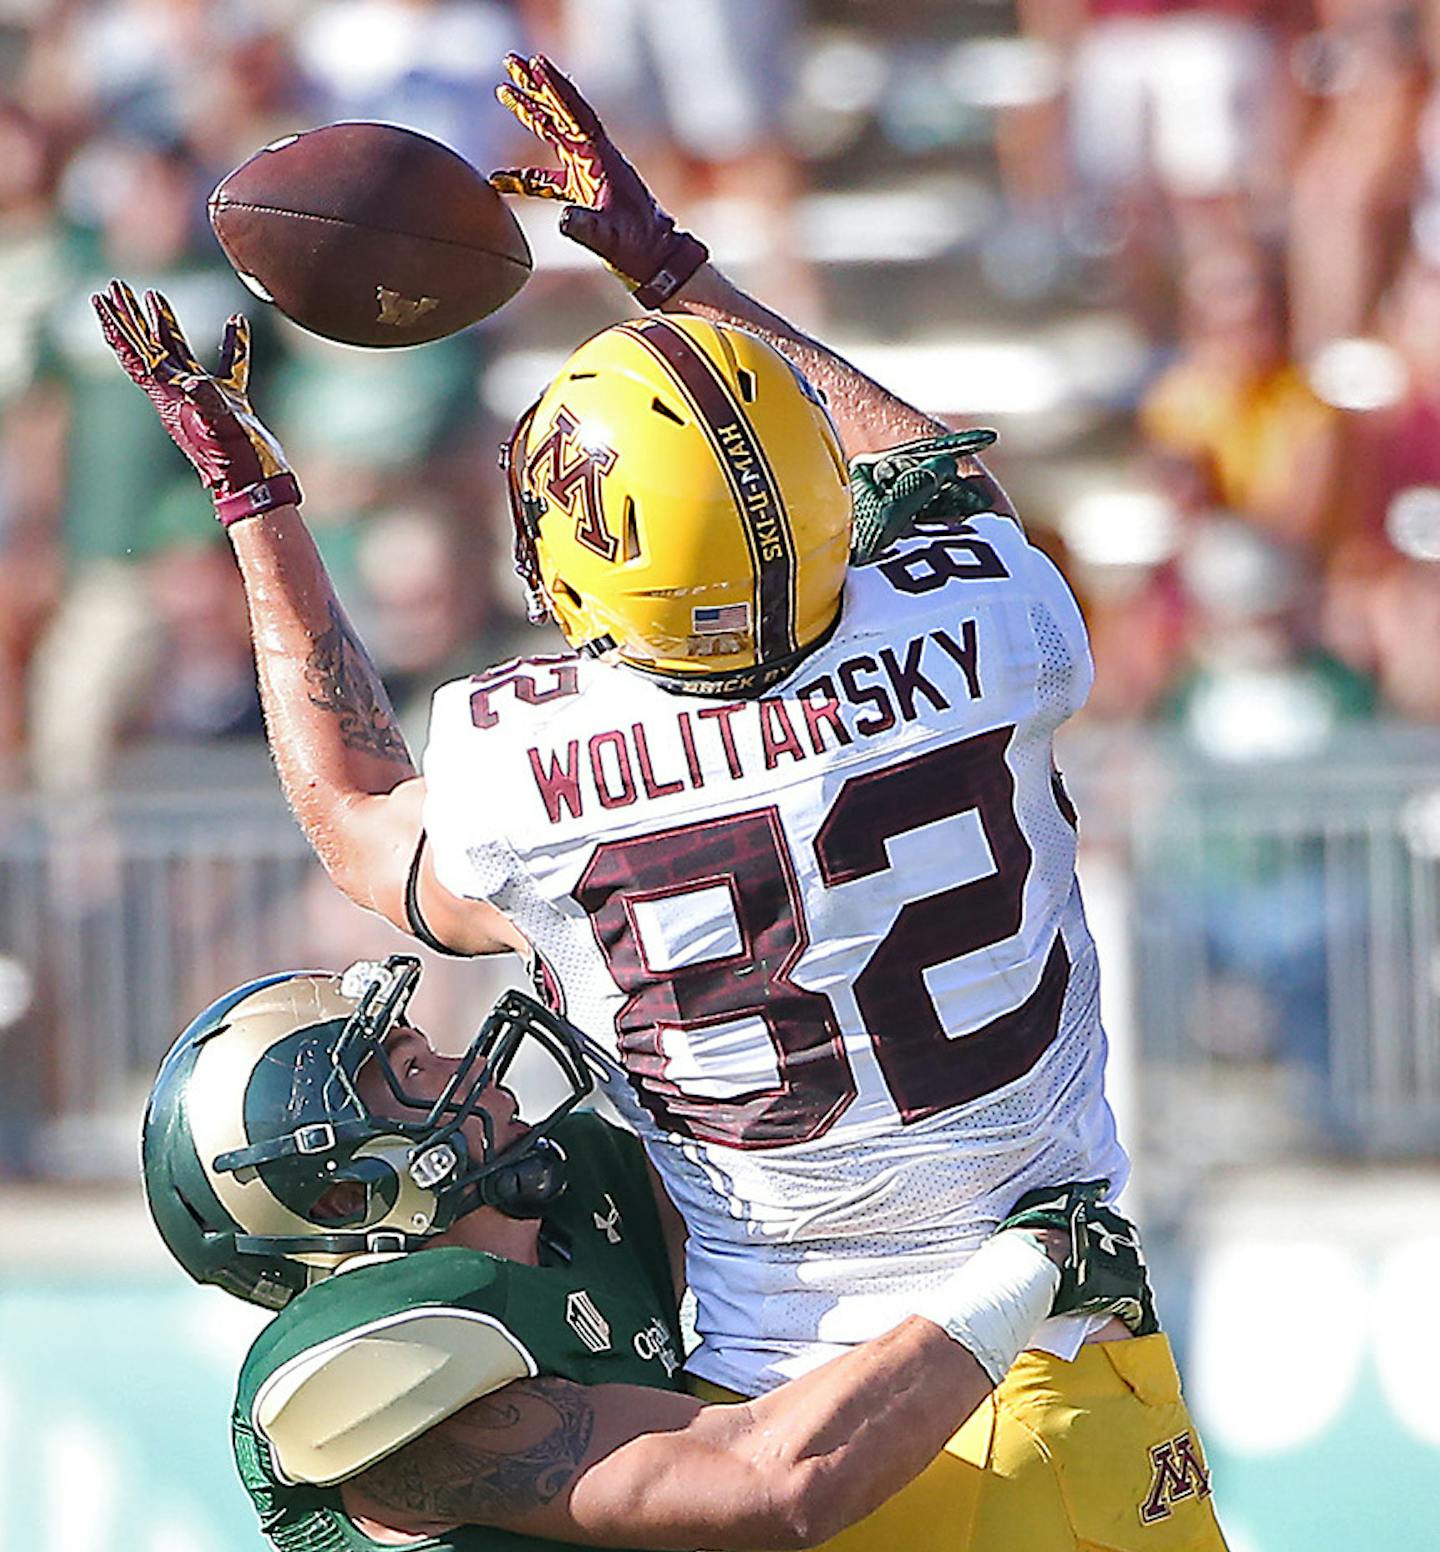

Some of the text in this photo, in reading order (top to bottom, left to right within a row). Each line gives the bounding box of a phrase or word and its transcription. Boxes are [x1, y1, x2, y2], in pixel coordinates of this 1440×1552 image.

[528, 404, 619, 563] M
[717, 423, 783, 562] SKI-U-MAH
[470, 653, 579, 729] 2
[527, 619, 983, 824] WOLITARSKY
[571, 725, 1071, 1149] 82
[1139, 1429, 1211, 1525] M
